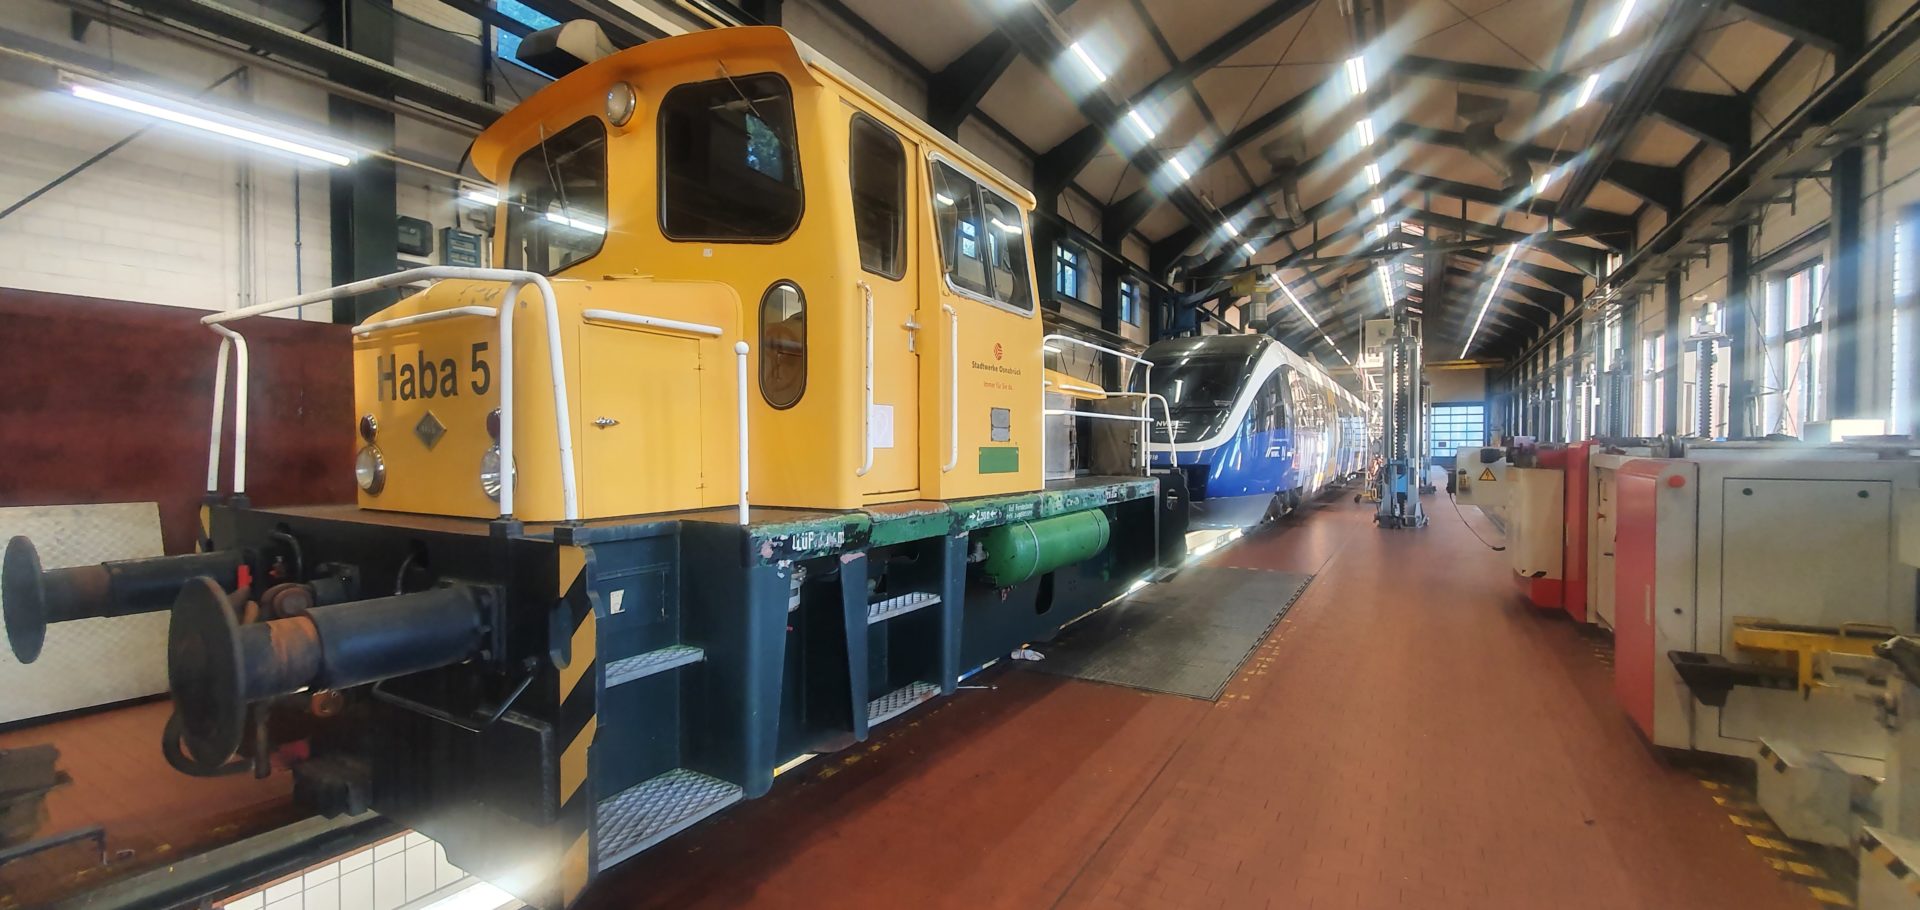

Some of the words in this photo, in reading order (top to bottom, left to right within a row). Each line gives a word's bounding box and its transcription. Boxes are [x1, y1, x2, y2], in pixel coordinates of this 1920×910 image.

[377, 350, 458, 401] Haba
[471, 341, 491, 395] 5
[971, 360, 998, 372] Stadtwerke
[999, 365, 1021, 376] Osnabrück
